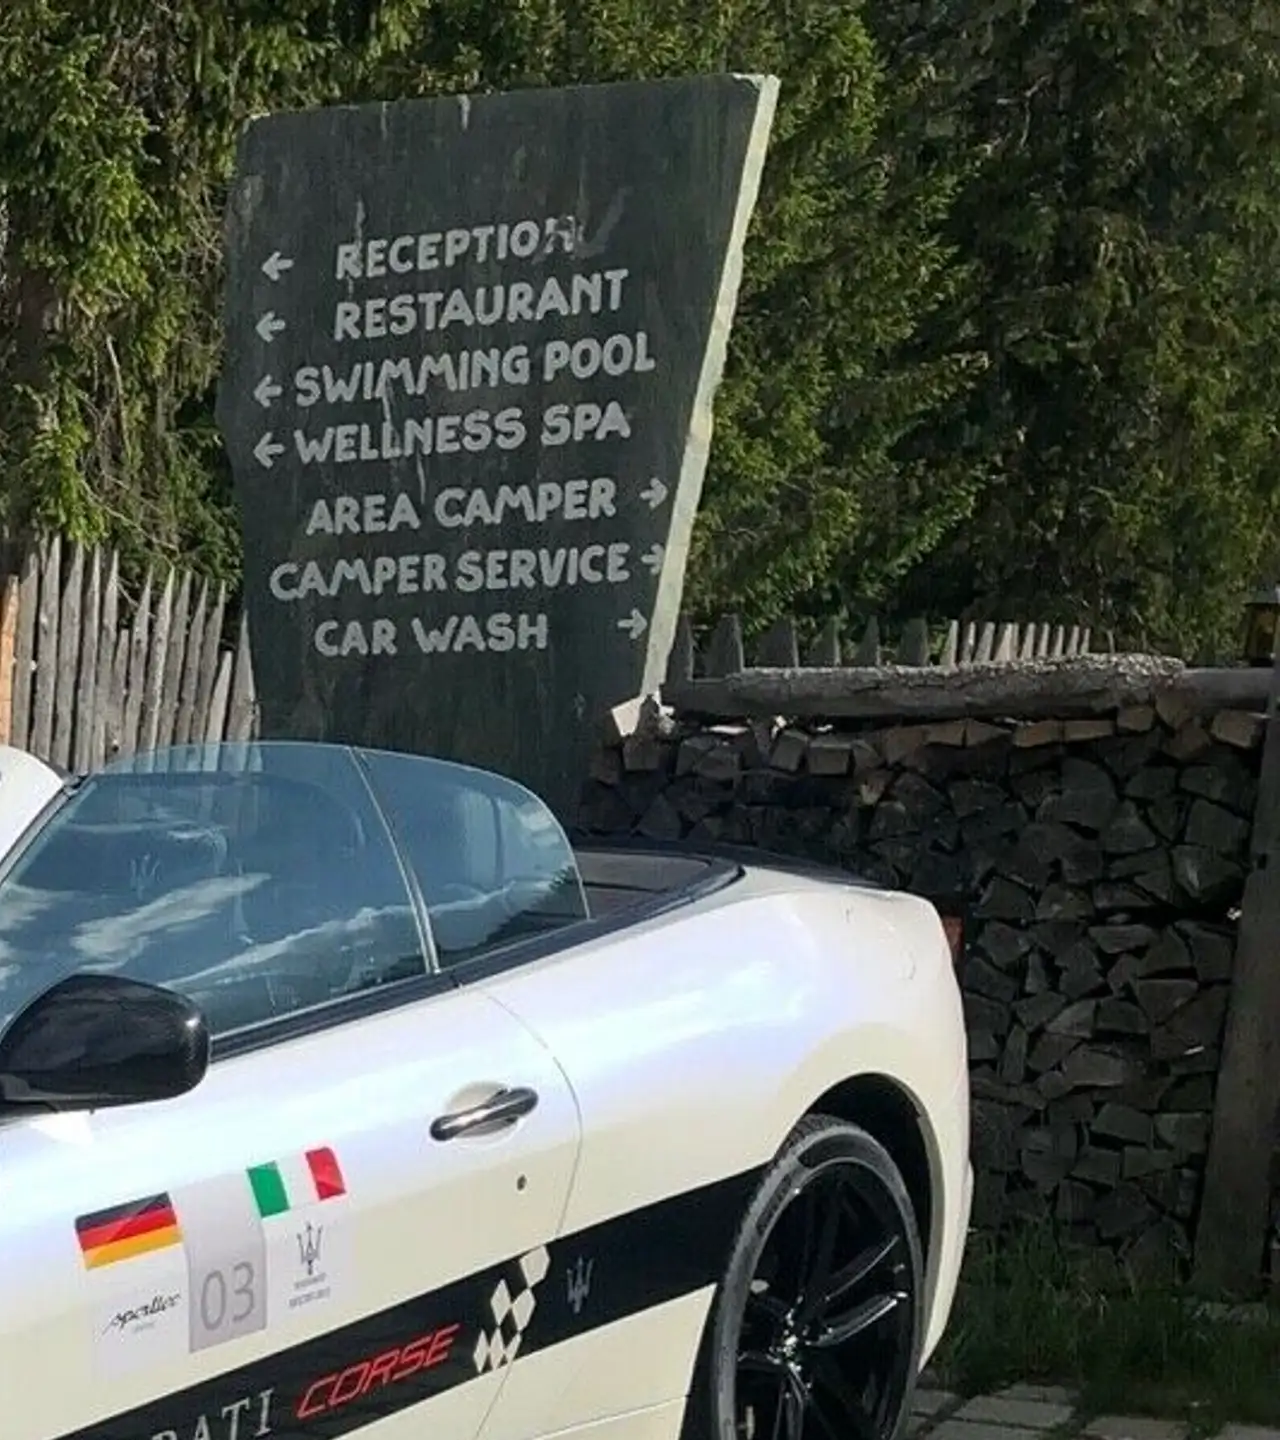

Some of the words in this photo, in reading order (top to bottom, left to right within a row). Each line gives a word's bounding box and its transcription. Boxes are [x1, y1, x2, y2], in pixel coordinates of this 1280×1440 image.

[335, 215, 579, 279] RECEPTION
[334, 269, 629, 340] RESTAURANT
[295, 348, 530, 407] SWIMMING
[543, 332, 656, 382] POOL
[294, 405, 523, 465] WELLNESS
[540, 401, 630, 446] SPA
[305, 493, 420, 536] AREA
[434, 477, 617, 528] CAMPER
[269, 552, 447, 601] CAMPER
[455, 542, 631, 593] SERVICE
[314, 618, 398, 657] CAR
[411, 612, 548, 652] WASH
[200, 1261, 255, 1330] 03
[297, 1323, 460, 1419] CORSE
